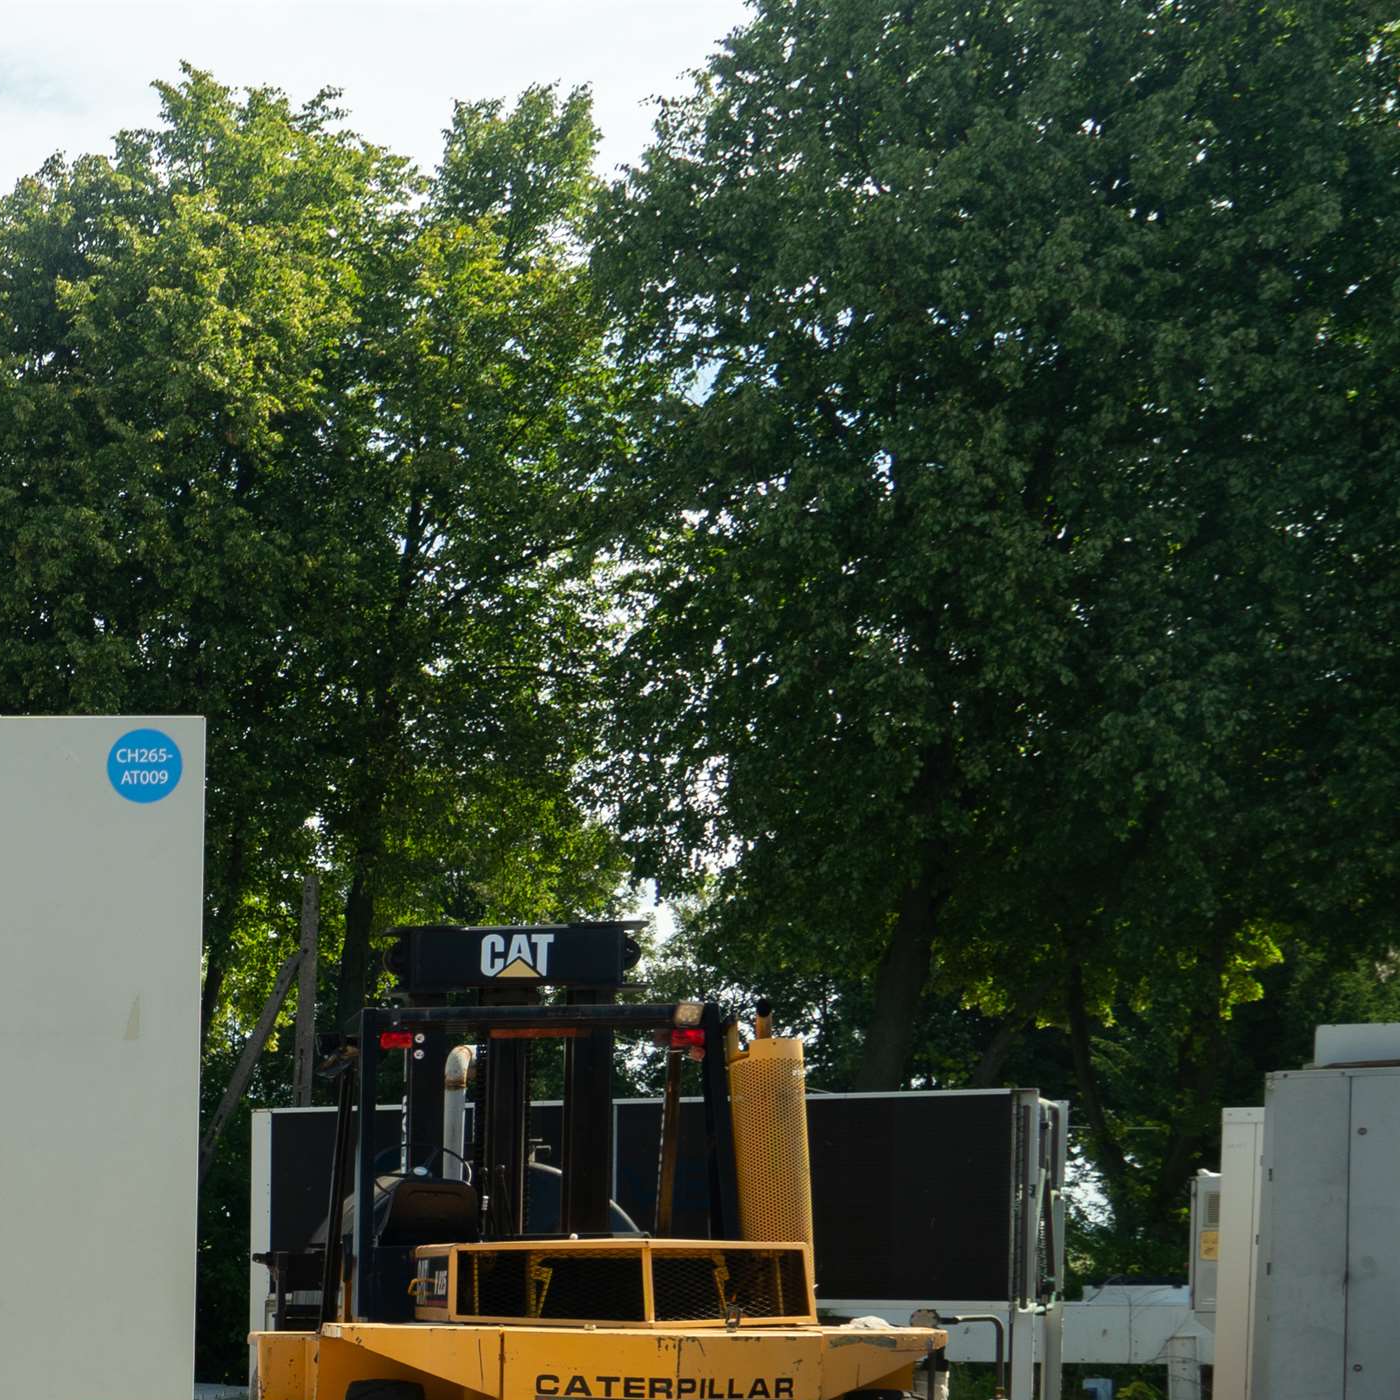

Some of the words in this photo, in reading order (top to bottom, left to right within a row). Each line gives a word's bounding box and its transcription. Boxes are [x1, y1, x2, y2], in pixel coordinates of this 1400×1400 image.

[120, 770, 168, 785] AT009
[480, 934, 554, 977] CAT
[535, 1374, 794, 1399] CATERPILLAR
